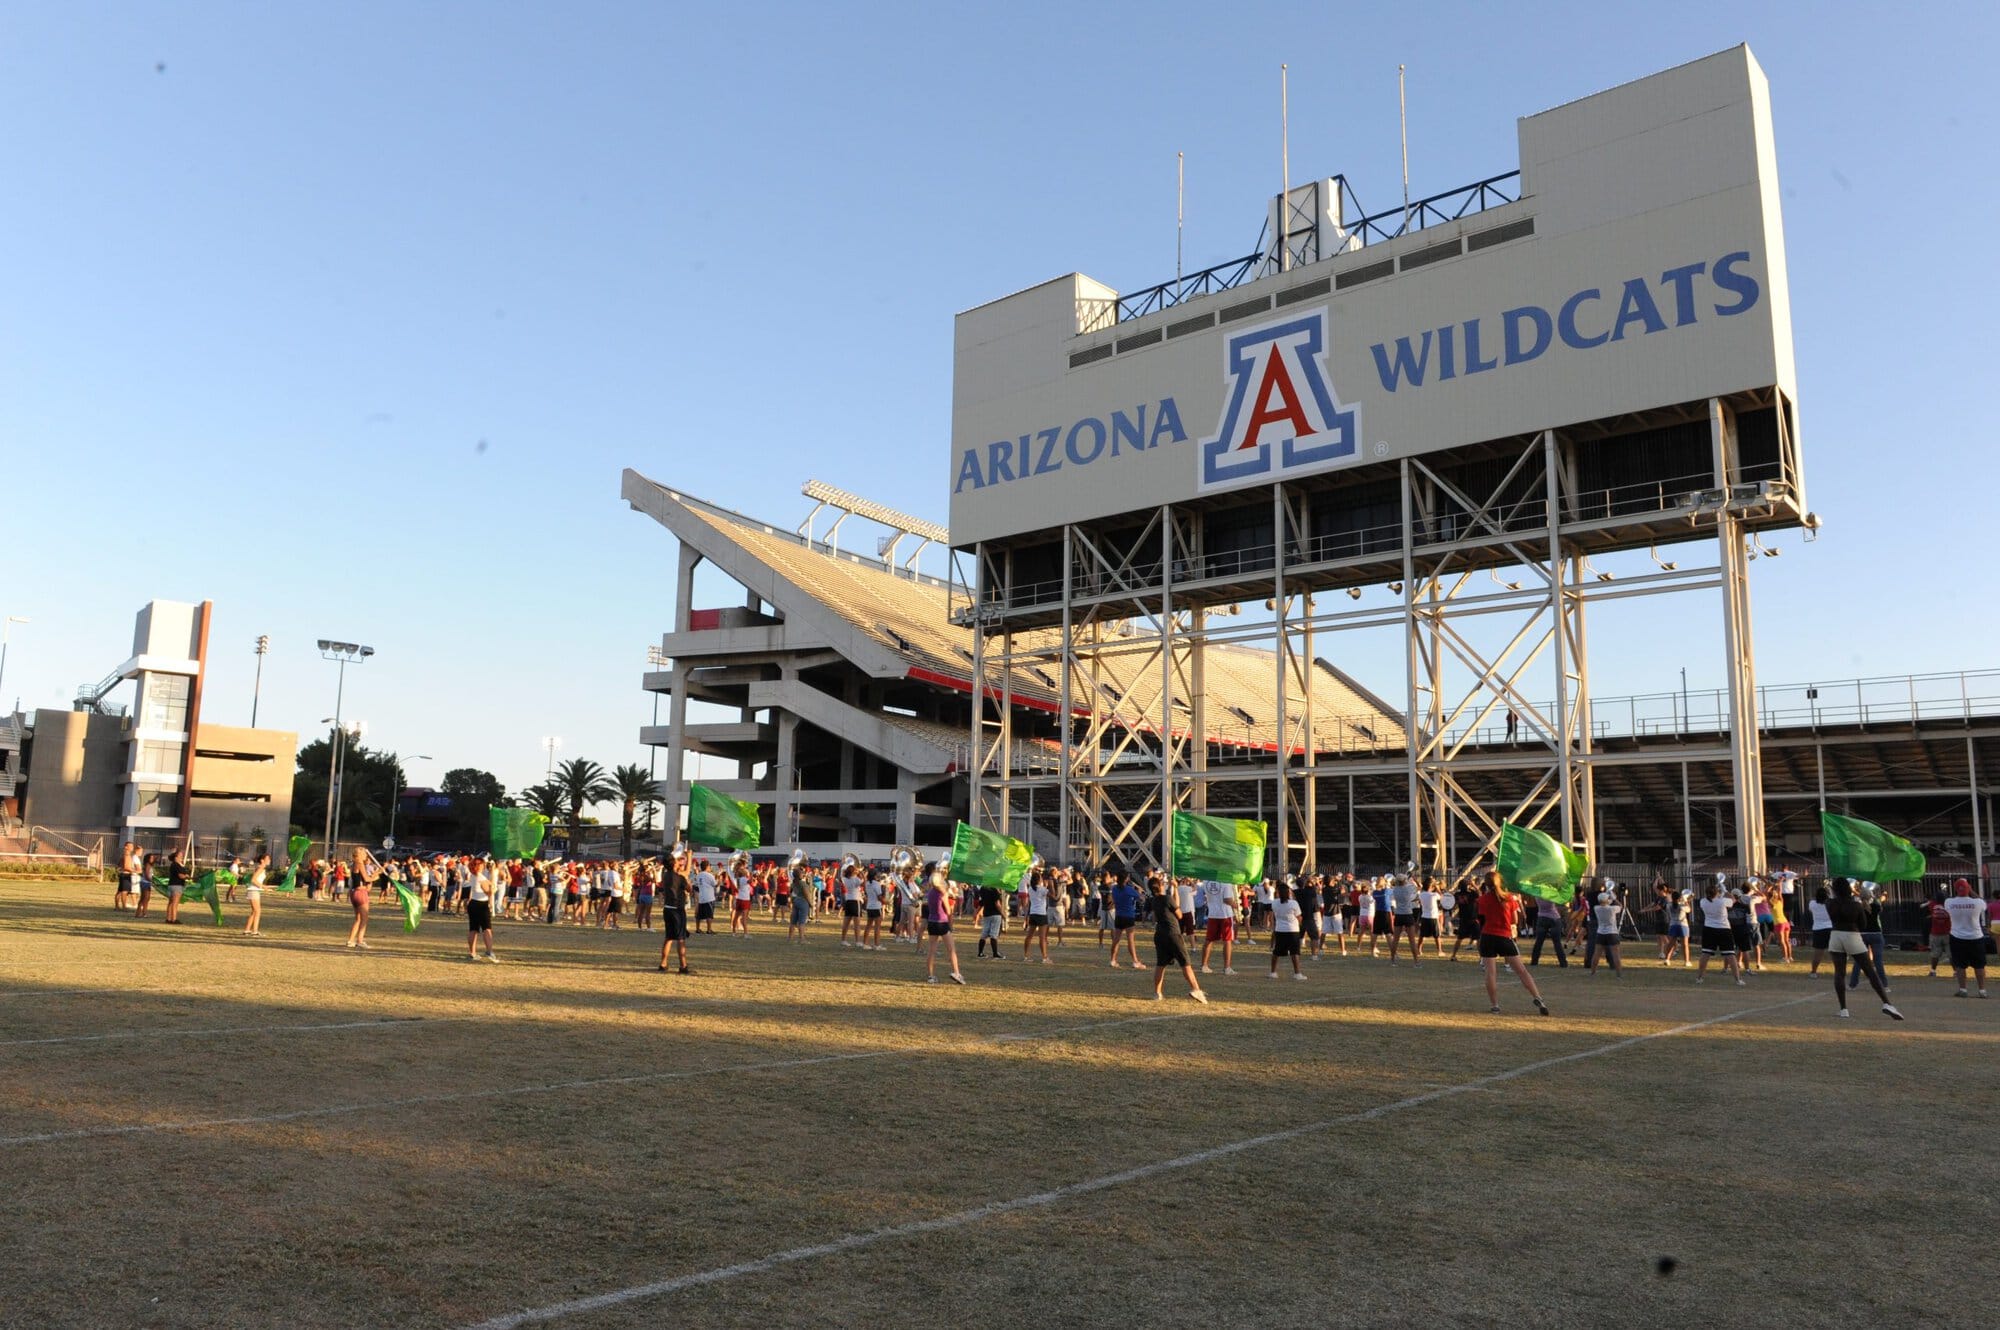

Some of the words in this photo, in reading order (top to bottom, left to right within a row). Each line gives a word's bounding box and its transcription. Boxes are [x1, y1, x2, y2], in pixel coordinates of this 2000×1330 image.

[956, 397, 1188, 494] ARIZONA
[1203, 313, 1356, 485] A
[1370, 251, 1761, 394] WILDCATS
